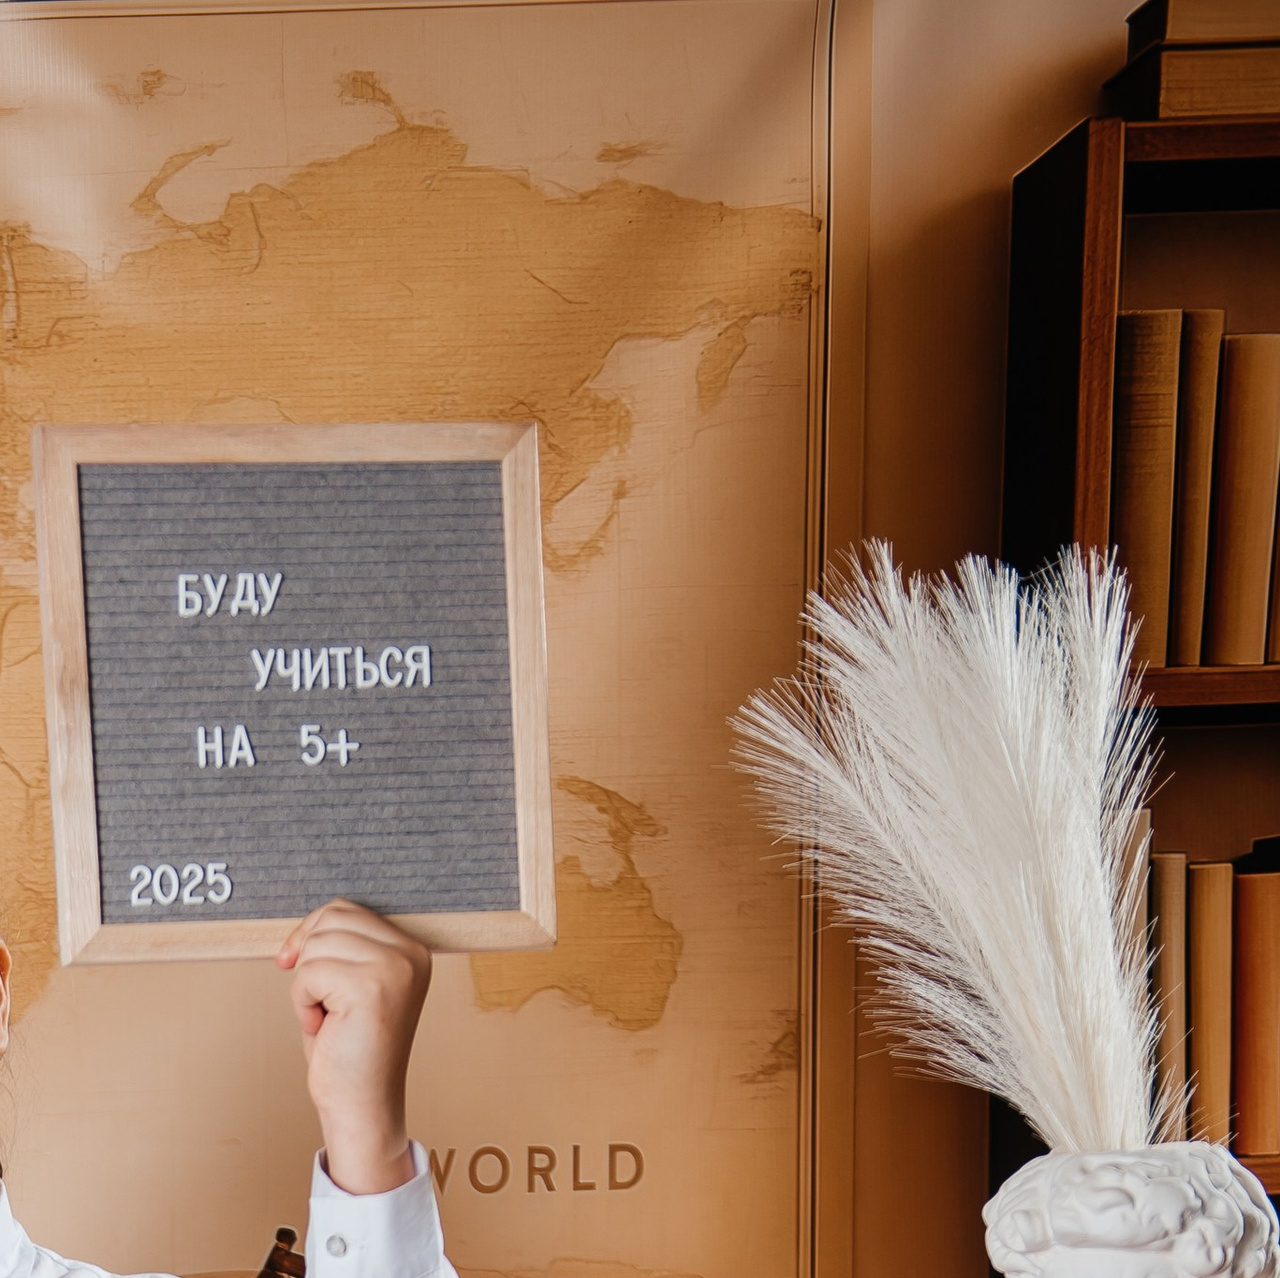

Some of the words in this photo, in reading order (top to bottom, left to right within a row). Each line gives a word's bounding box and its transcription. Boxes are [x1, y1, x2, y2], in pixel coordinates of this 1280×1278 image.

[177, 571, 282, 618] БУДУ
[250, 645, 432, 691] УЧИТЬСЯ
[197, 724, 256, 768] НА
[300, 723, 360, 766] 5+
[129, 861, 233, 907] 2025
